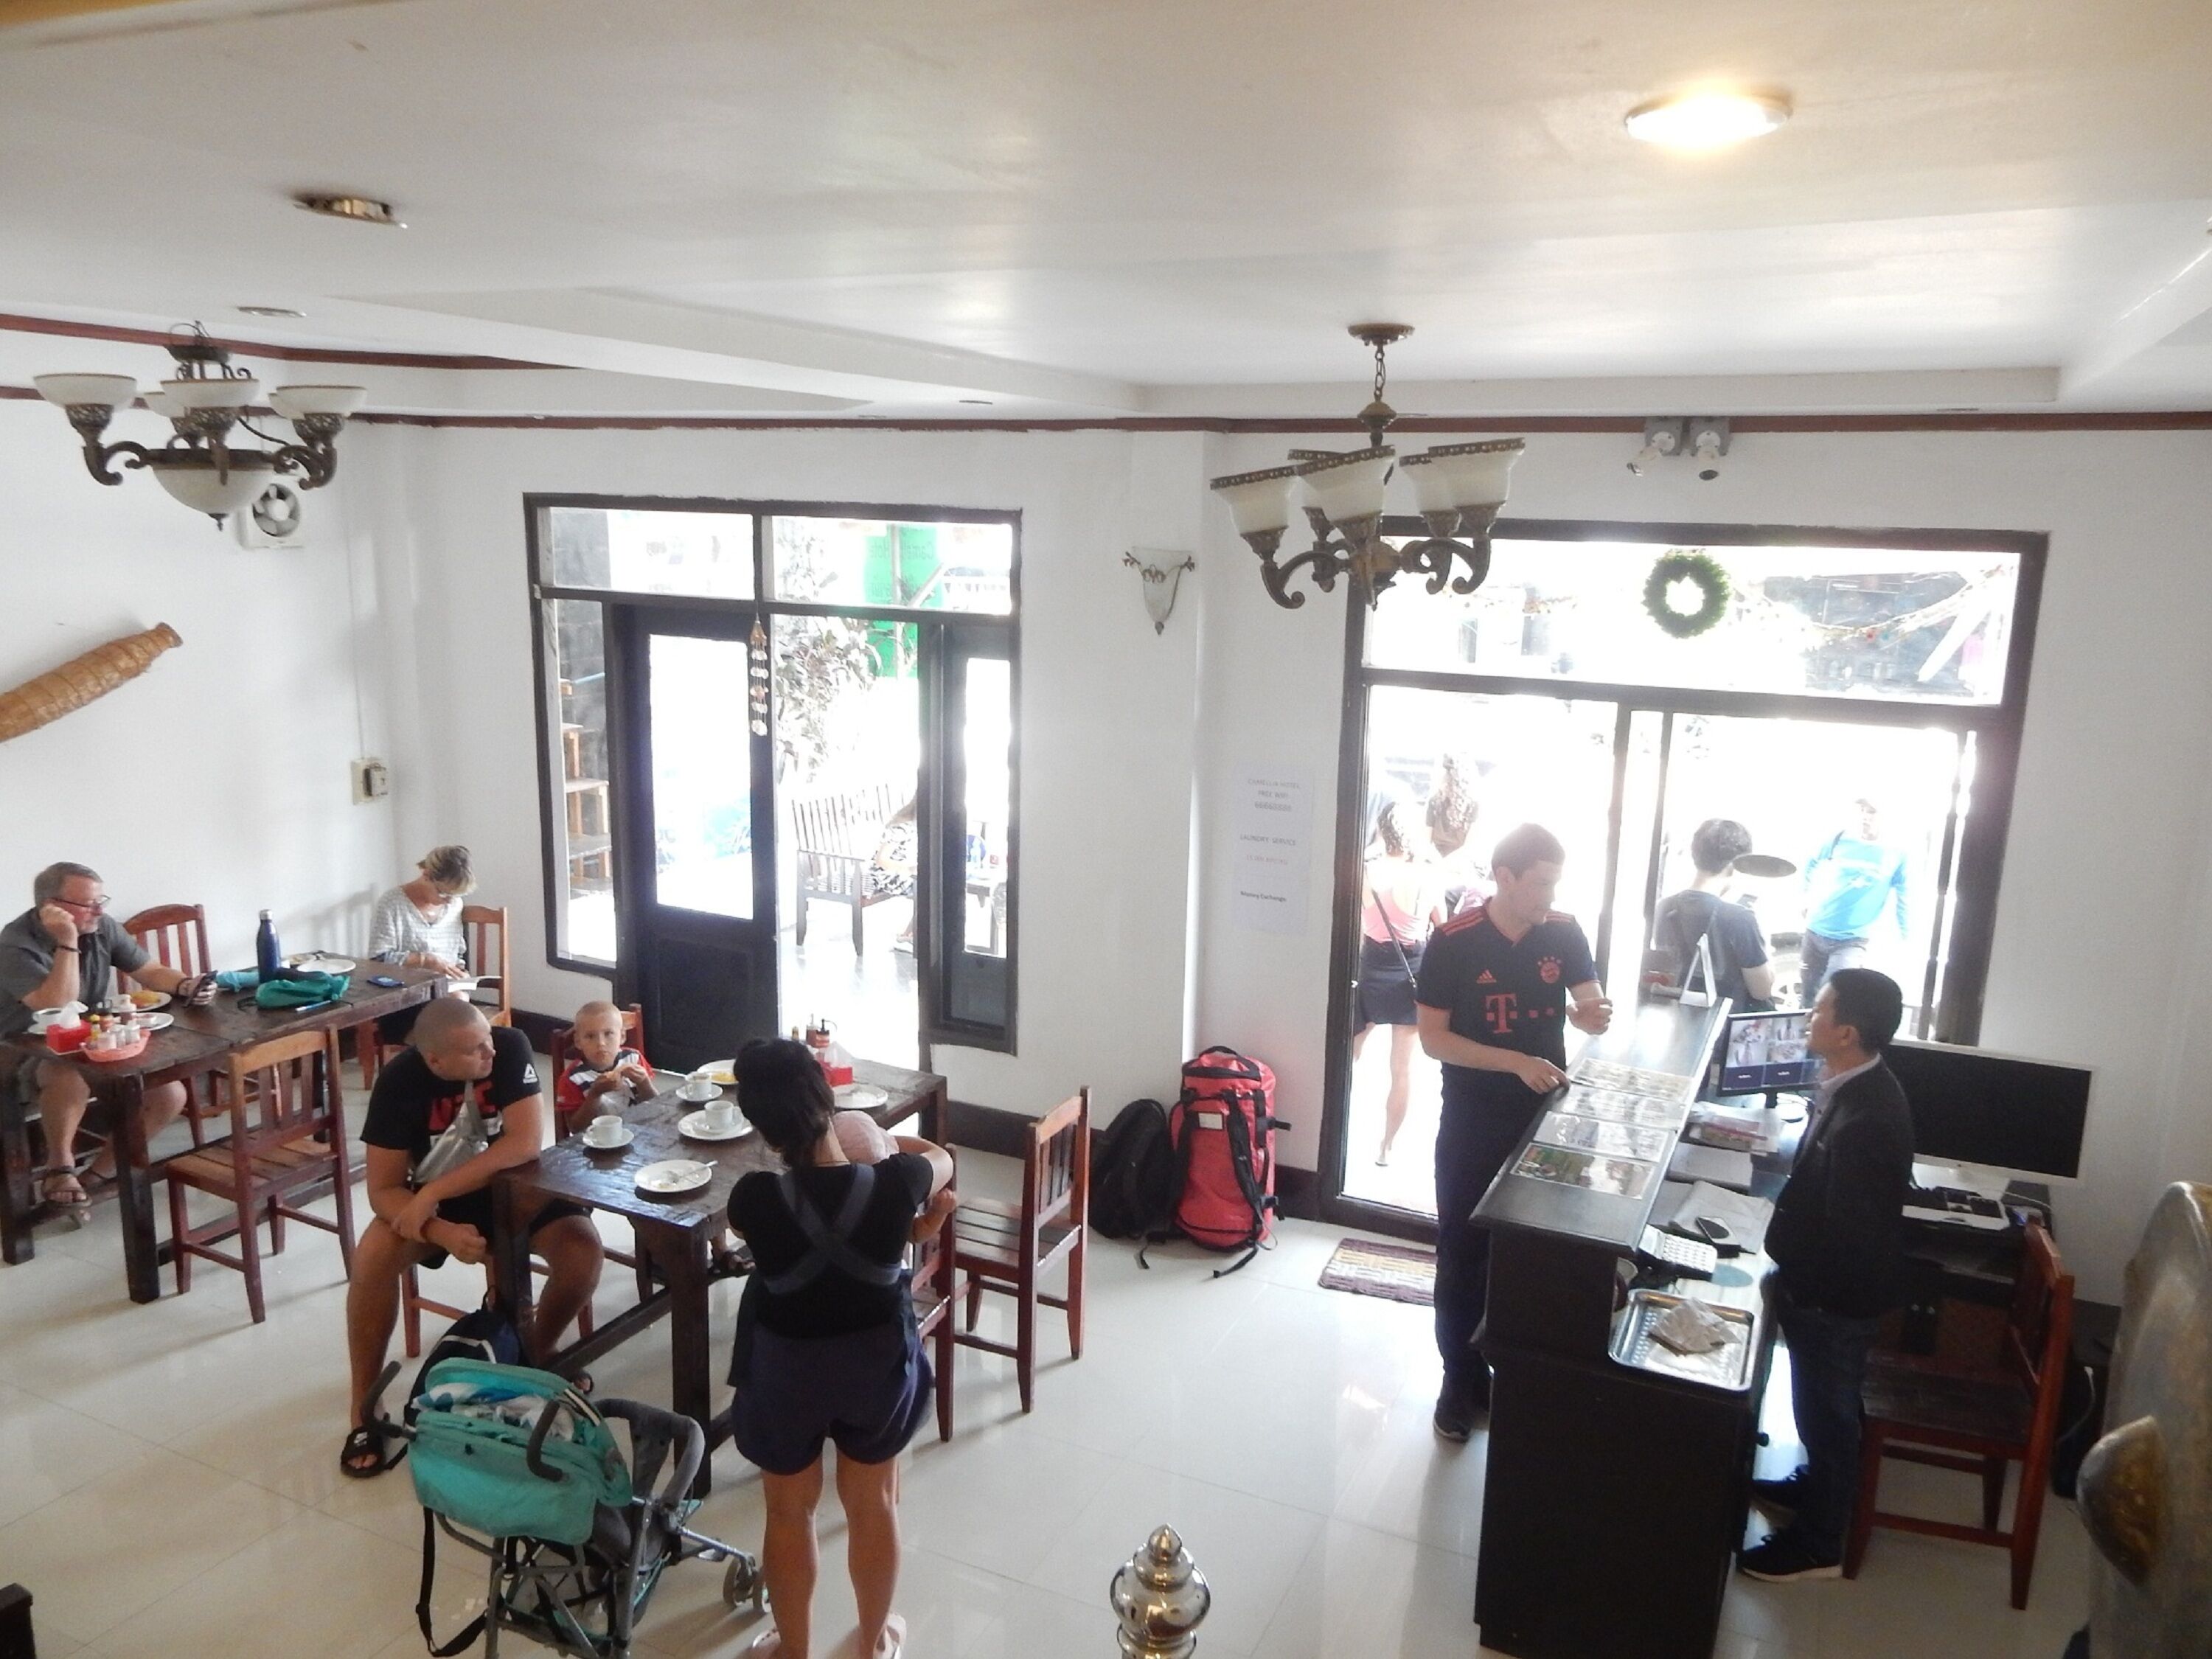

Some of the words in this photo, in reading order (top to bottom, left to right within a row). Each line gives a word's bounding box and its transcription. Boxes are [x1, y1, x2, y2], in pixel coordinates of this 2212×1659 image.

[1239, 833, 1269, 843] LAUNDRY
[1272, 837, 1296, 846] SERVICE
[1486, 994, 1517, 1034] T
